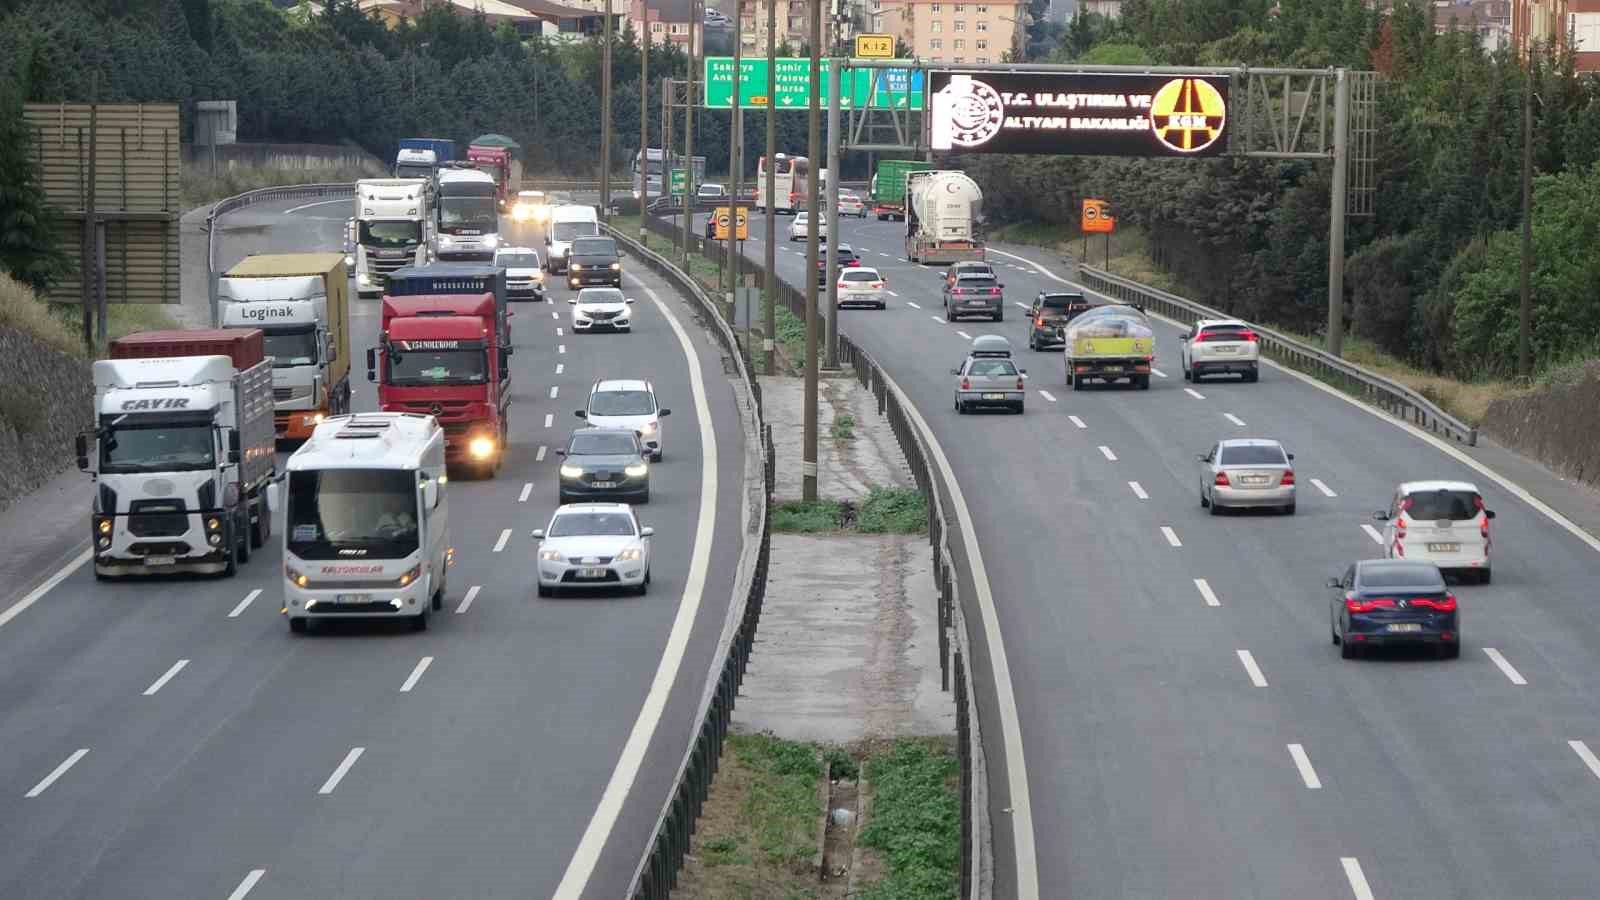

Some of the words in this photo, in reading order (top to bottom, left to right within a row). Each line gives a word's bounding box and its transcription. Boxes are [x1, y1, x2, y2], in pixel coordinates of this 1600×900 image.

[1001, 92, 1032, 105] T.C.
[1128, 94, 1151, 108] VE
[1003, 116, 1068, 128] ALTYAPI
[1168, 115, 1206, 129] KGM
[241, 306, 295, 321] Loginak
